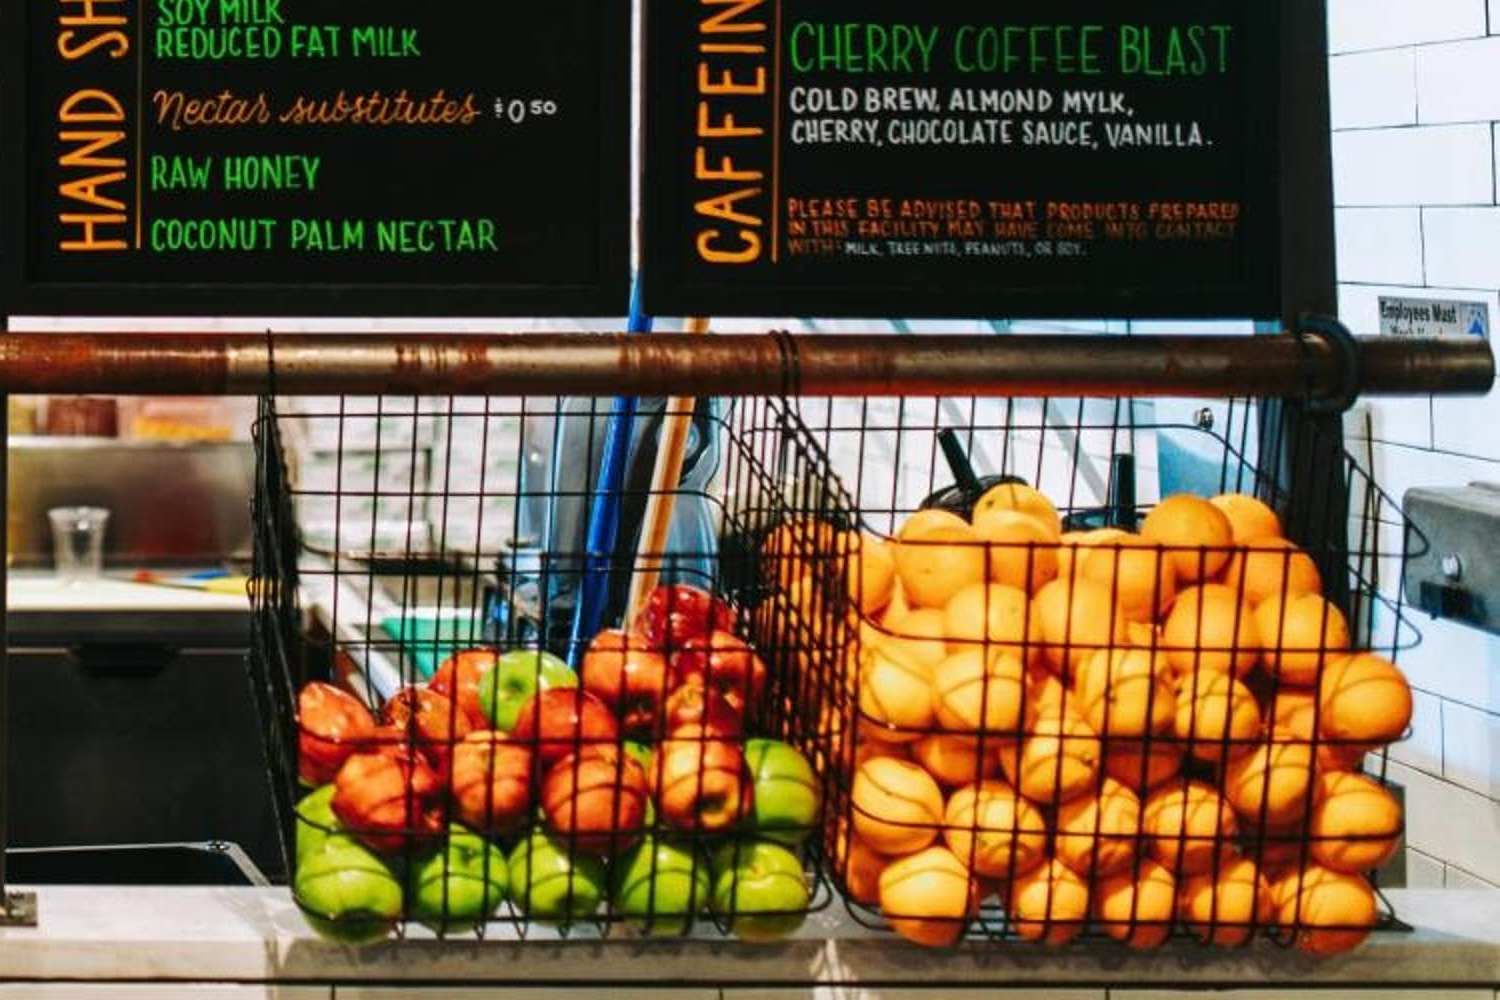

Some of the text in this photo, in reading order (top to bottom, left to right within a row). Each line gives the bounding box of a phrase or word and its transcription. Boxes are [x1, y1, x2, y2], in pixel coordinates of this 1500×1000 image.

[156, 24, 421, 60] REDUCED FAT MILK
[790, 21, 1231, 76] CHERRY COFFEE BLAST
[152, 89, 270, 131] Nectar
[279, 89, 482, 125] substitutes
[789, 86, 859, 114] COLD
[948, 87, 1053, 114] ALMOND
[887, 118, 1013, 145] CHOCOLATE
[58, 89, 128, 251] HAND
[151, 154, 320, 191] RAW HONEY
[787, 197, 857, 219] PLEASE
[867, 198, 892, 219] BE
[900, 199, 981, 221] ADVISED
[988, 200, 1035, 220] THAT
[1046, 201, 1139, 221] PRODUCTS
[151, 217, 498, 253] COCONUT PALM NECTAR
